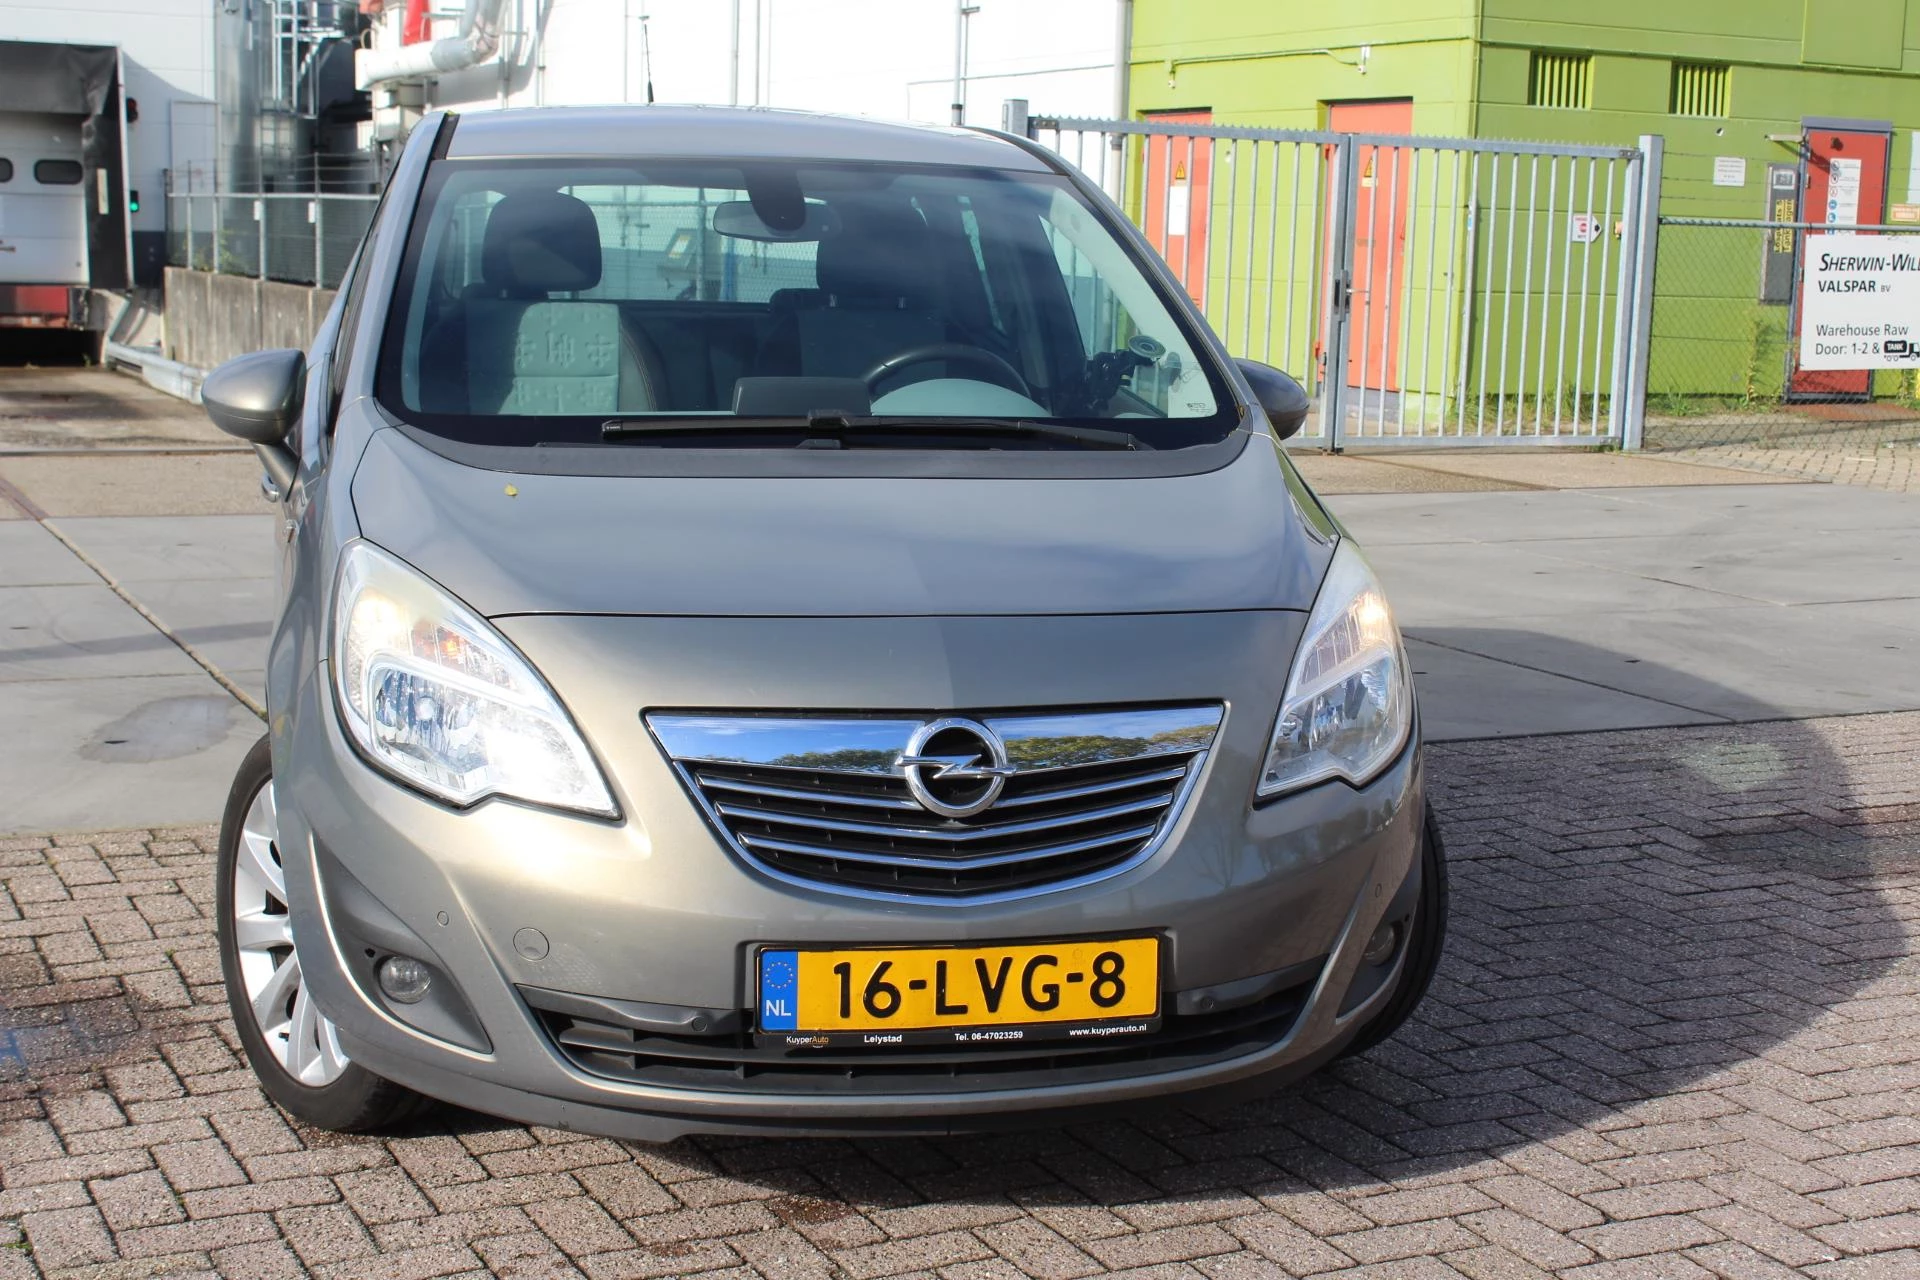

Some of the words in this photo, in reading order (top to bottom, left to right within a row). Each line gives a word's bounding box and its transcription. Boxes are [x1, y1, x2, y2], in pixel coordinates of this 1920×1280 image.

[1782, 200, 1793, 251] Tankagen
[1818, 280, 1876, 293] VALSPAR
[1816, 324, 1880, 336] Warehouse
[1884, 324, 1909, 336] Raw
[1815, 343, 1847, 355] Door:
[1852, 343, 1868, 354] 1-2
[1872, 343, 1880, 354] &
[1886, 343, 1904, 351] TANK
[833, 951, 1126, 1018] 16-LVG-8
[765, 999, 792, 1017] NL
[955, 1033, 969, 1041] Tel.
[971, 1030, 1023, 1041] 06-47023259
[1069, 1024, 1147, 1037] www.kuyperauto.nl
[786, 1035, 829, 1045] KuyperAuto
[864, 1034, 903, 1043] Lelystad
